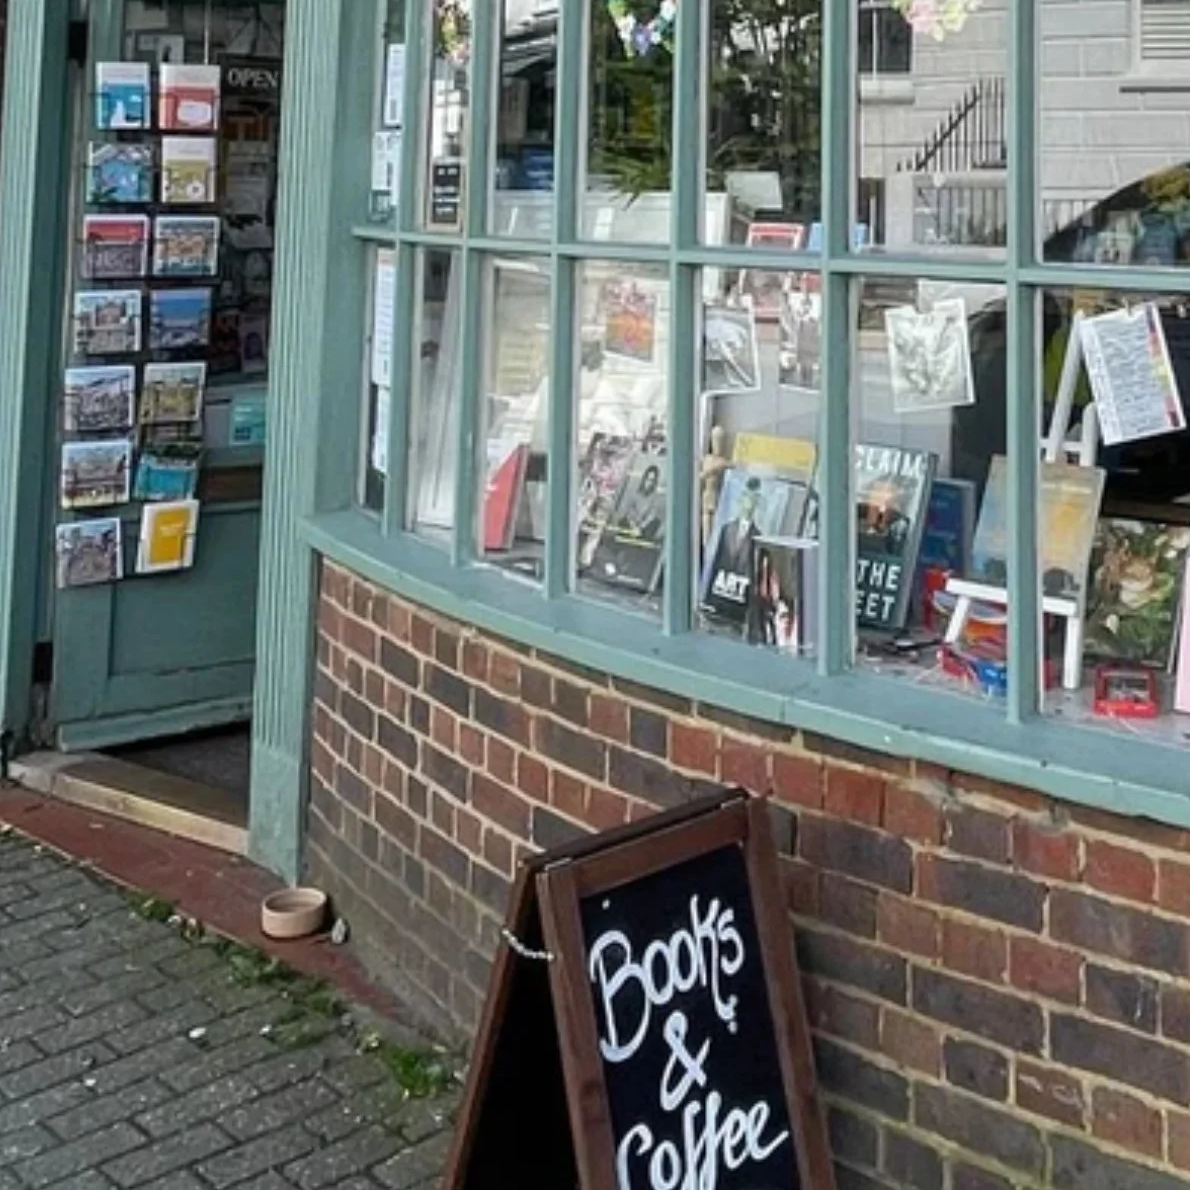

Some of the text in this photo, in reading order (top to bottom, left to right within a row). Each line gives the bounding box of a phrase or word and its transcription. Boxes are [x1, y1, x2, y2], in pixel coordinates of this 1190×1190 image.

[227, 67, 279, 89] OPEN
[856, 559, 902, 592] THE
[589, 894, 746, 1062] Books
[660, 1009, 712, 1111] &
[616, 1090, 791, 1190] Coffee
